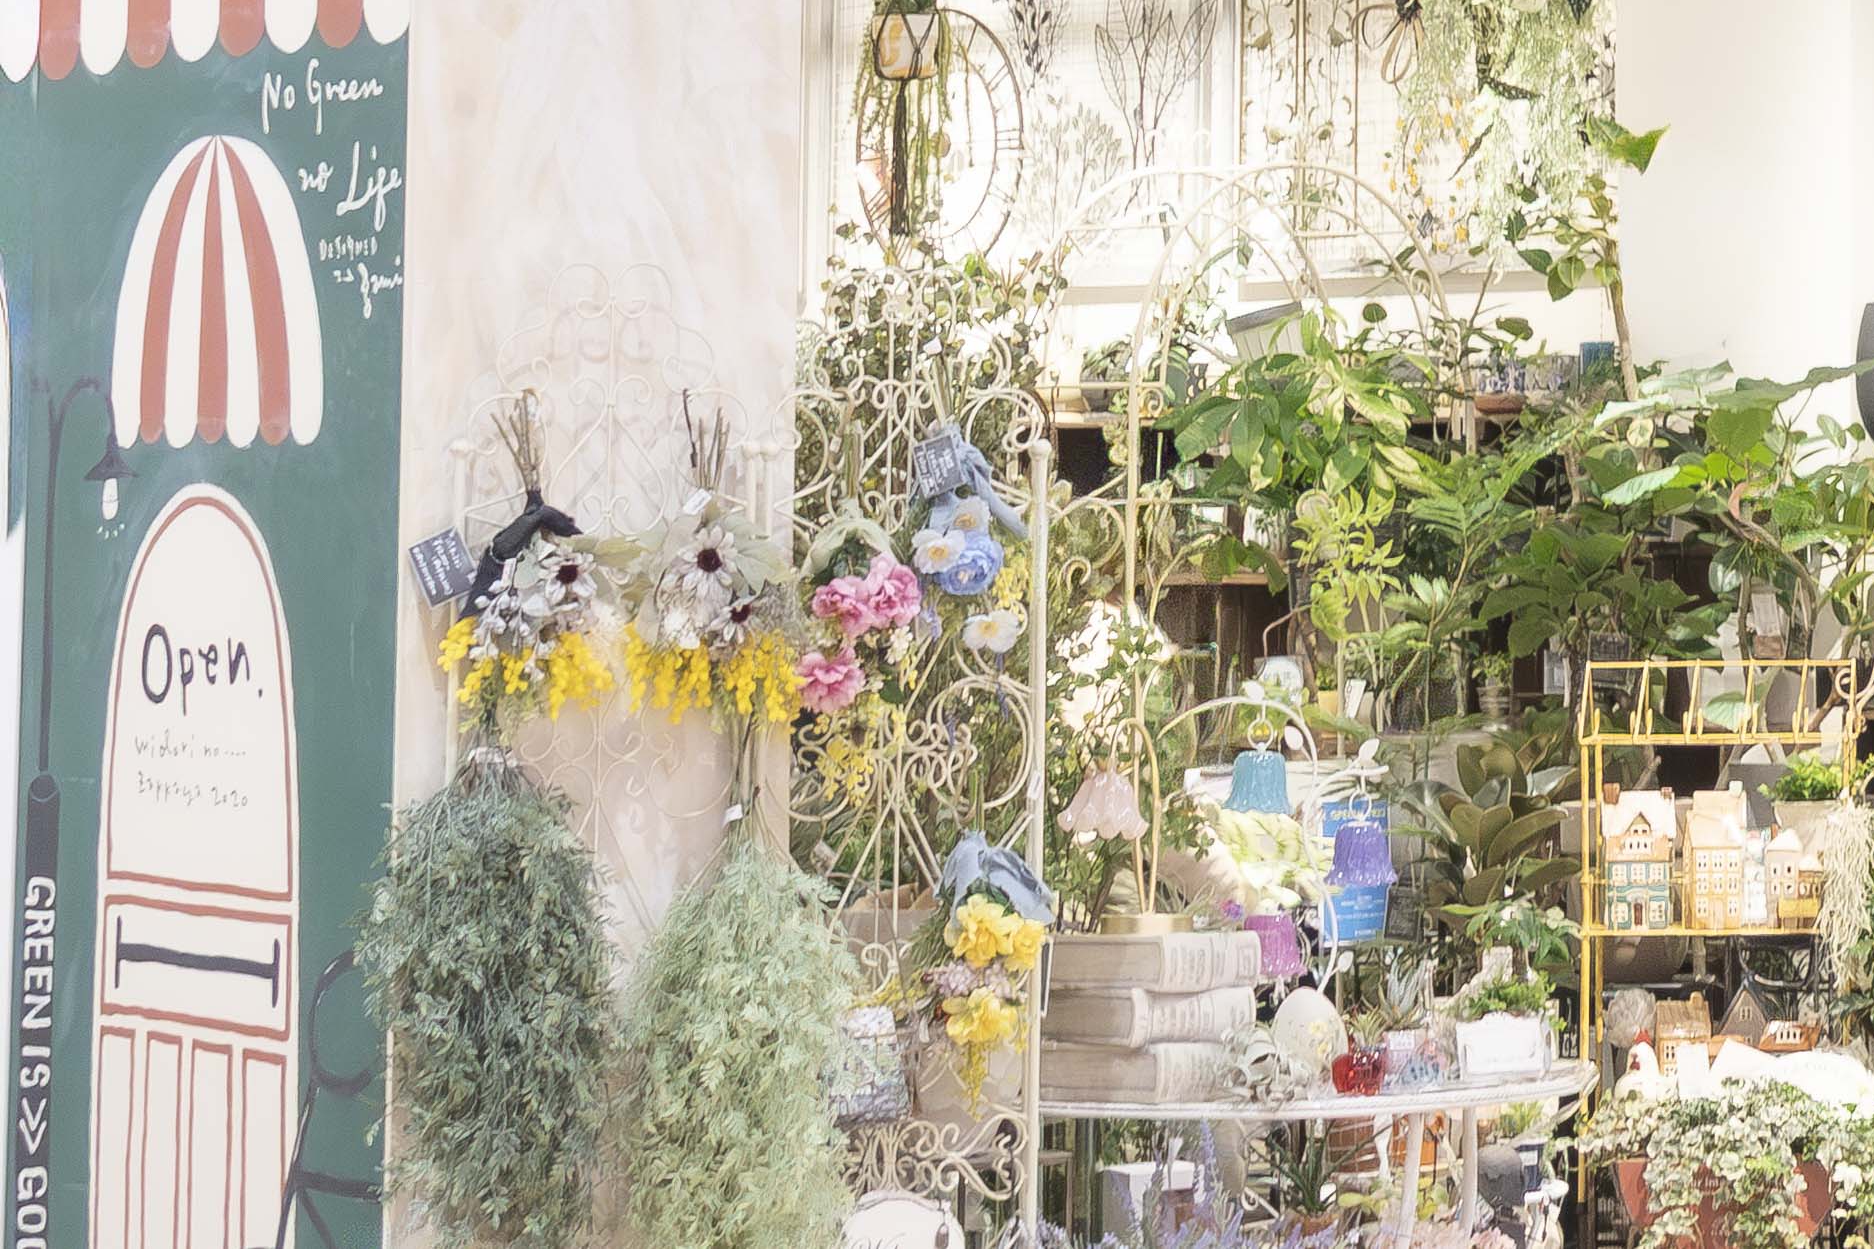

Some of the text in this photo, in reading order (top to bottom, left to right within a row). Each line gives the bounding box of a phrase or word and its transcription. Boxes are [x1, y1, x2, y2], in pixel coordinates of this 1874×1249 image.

[261, 57, 384, 136] No Green
[298, 140, 402, 232] no Life
[21, 875, 56, 1030] GREEN
[19, 1044, 52, 1089] IS
